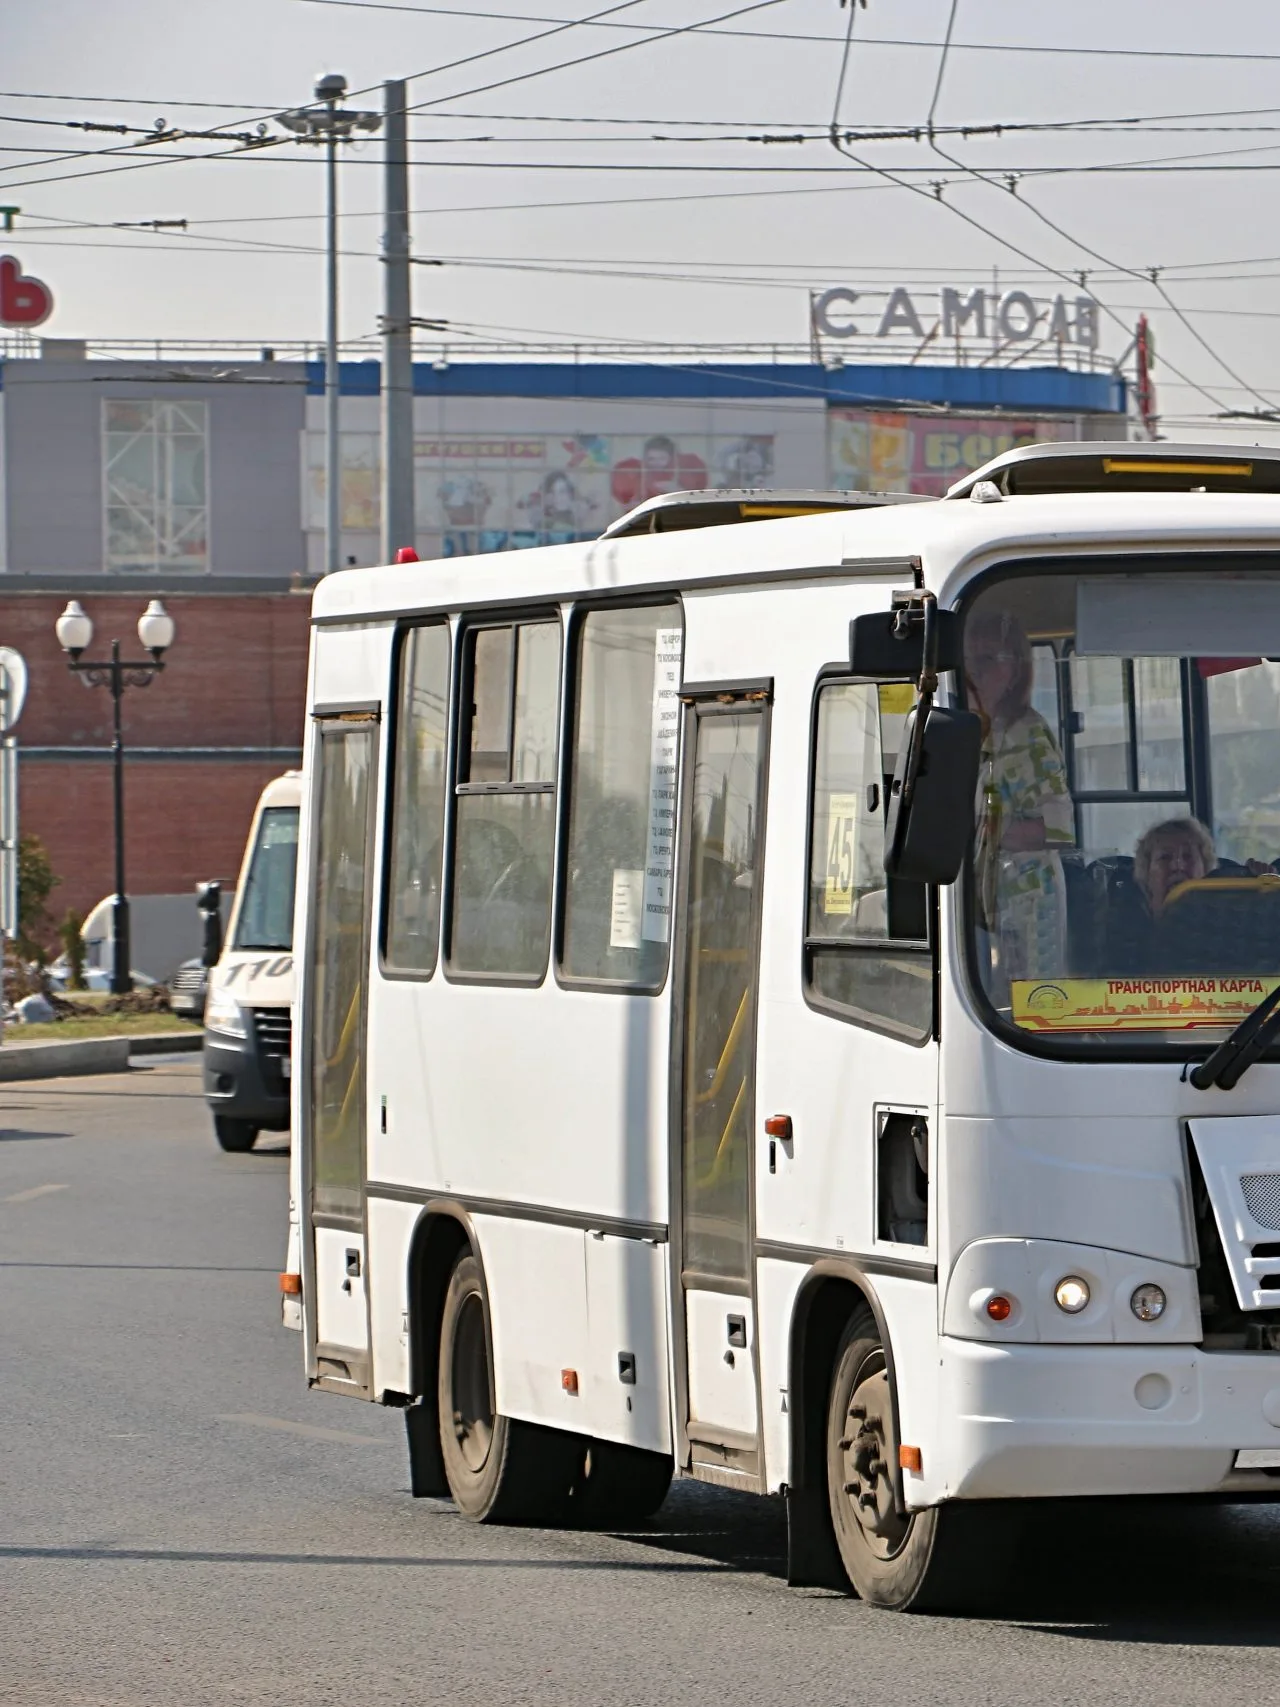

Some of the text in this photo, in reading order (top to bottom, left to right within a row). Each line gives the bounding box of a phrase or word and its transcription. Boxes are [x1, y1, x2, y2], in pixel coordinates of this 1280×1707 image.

[828, 817, 854, 893] 45
[1107, 979, 1263, 995] ТРАНСПОРТНАЯ КАРТА
